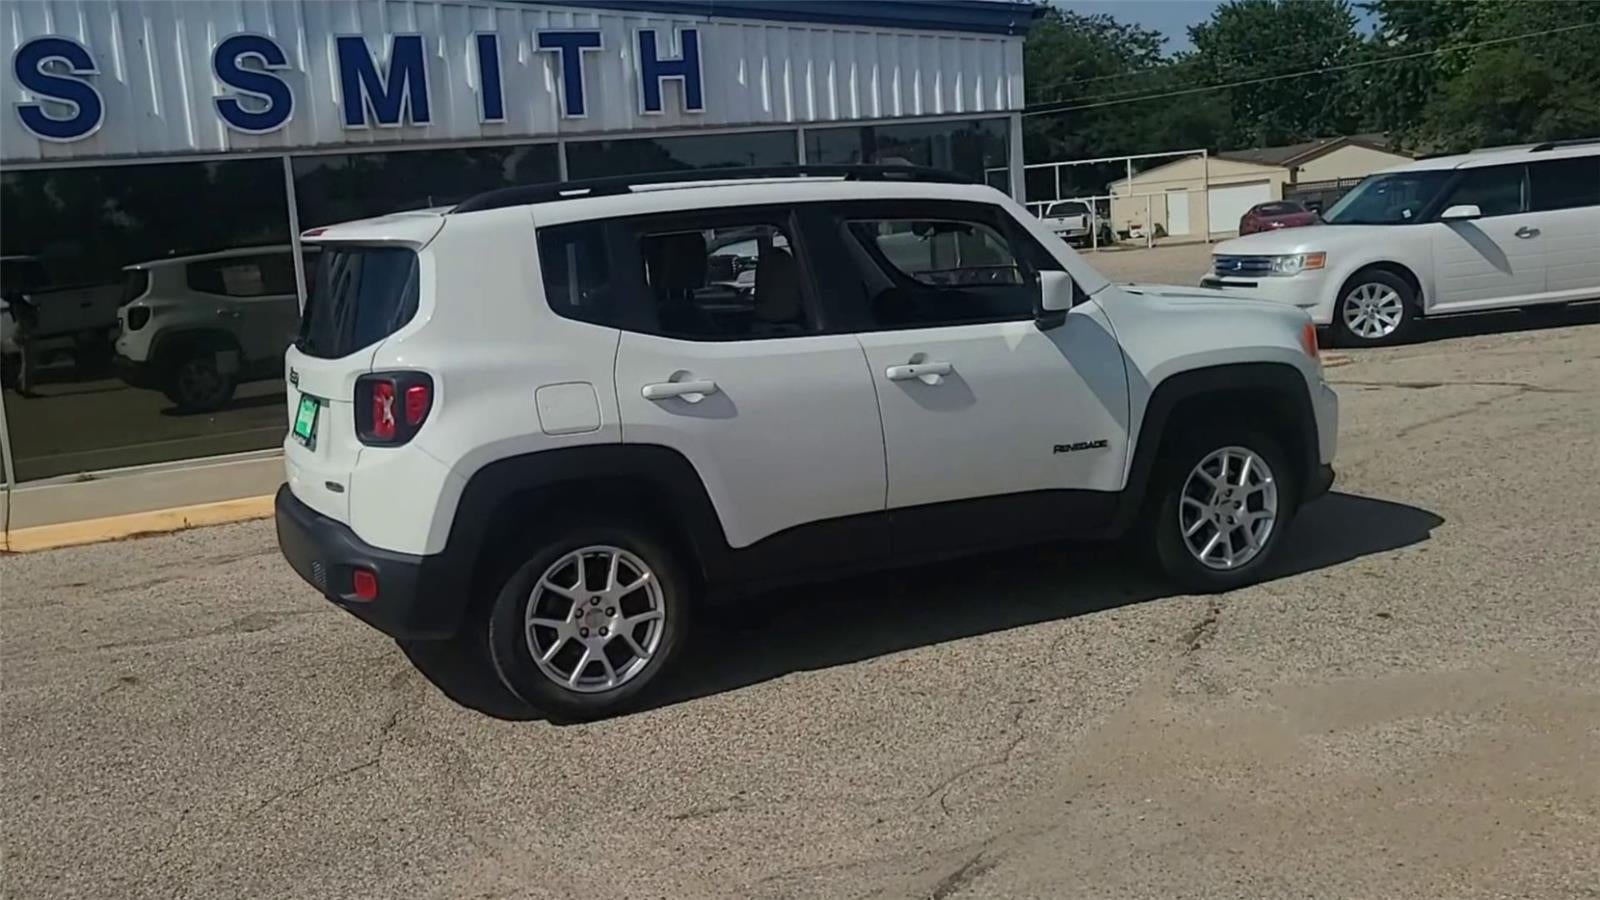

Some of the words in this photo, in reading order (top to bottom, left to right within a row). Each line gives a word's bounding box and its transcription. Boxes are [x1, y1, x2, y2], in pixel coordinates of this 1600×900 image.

[13, 35, 105, 142] S
[211, 28, 704, 134] SMITH
[1053, 439, 1108, 455] RENEGADE
